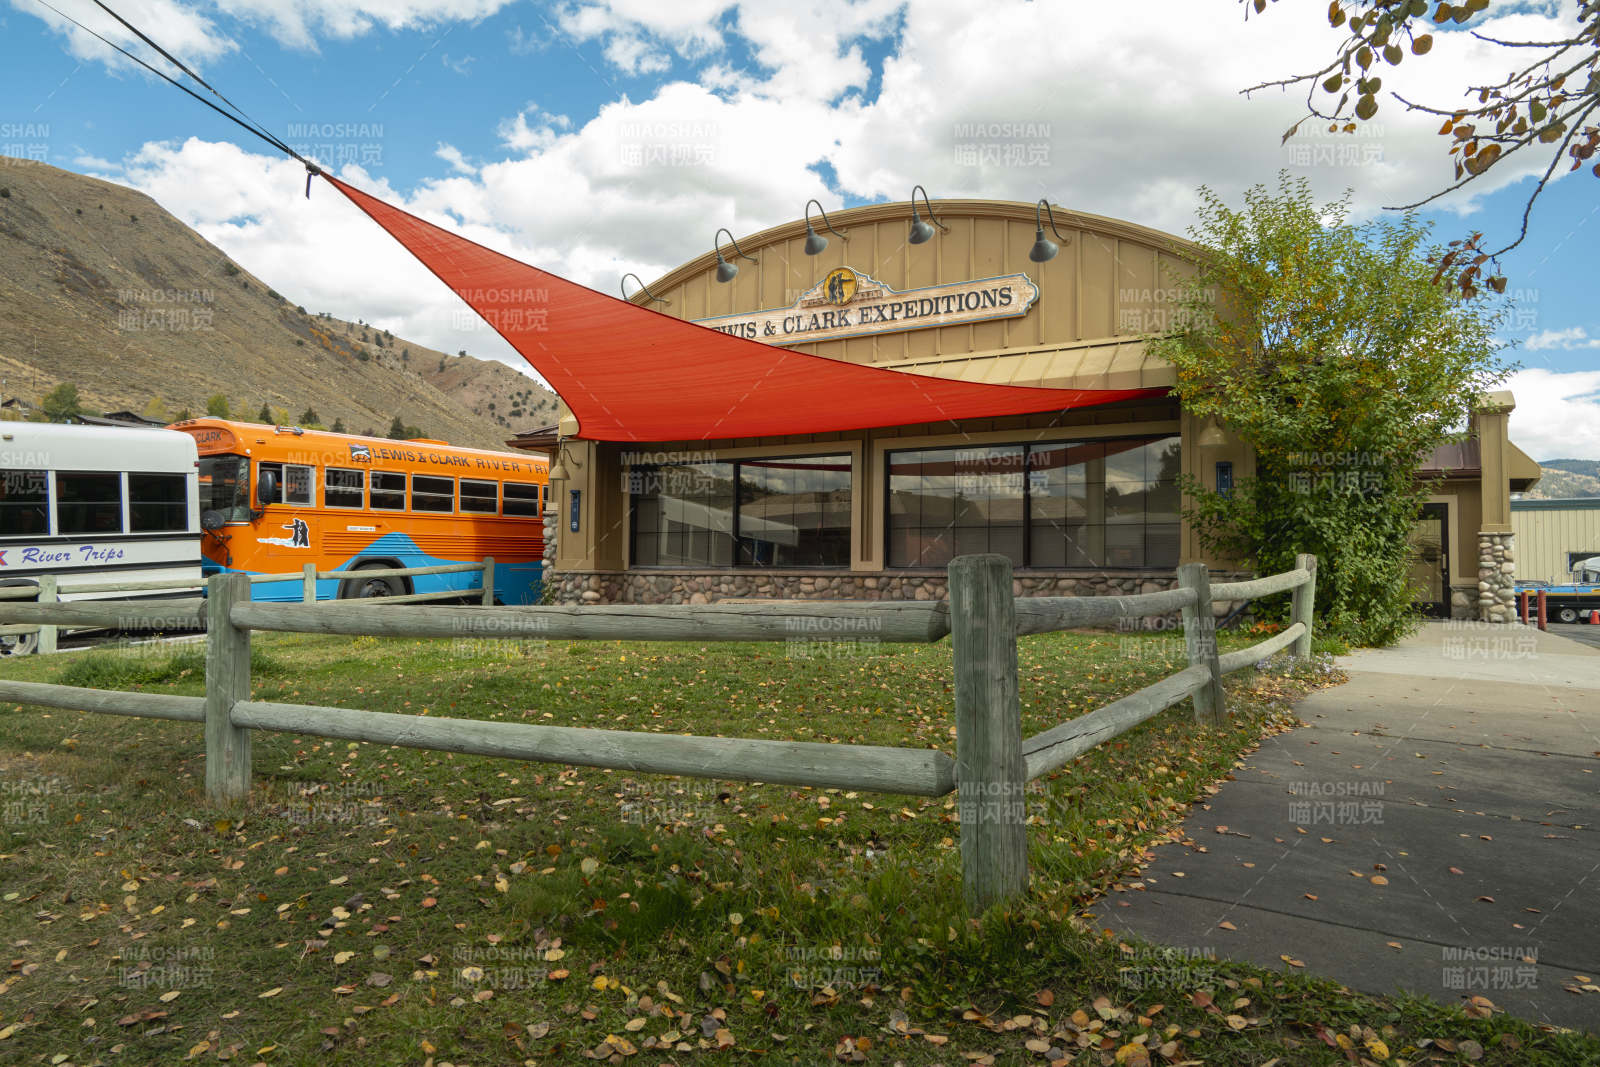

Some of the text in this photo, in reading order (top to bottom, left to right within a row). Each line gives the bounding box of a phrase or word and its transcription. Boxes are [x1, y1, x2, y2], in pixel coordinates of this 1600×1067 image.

[712, 321, 757, 339] WIS
[764, 320, 776, 336] &
[783, 309, 851, 334] CLARK
[858, 286, 1012, 324] EXPEDITIONS
[372, 447, 548, 475] LEWIS & CLARK RIVER TRI
[22, 547, 71, 563] River
[79, 545, 124, 563] Trips
